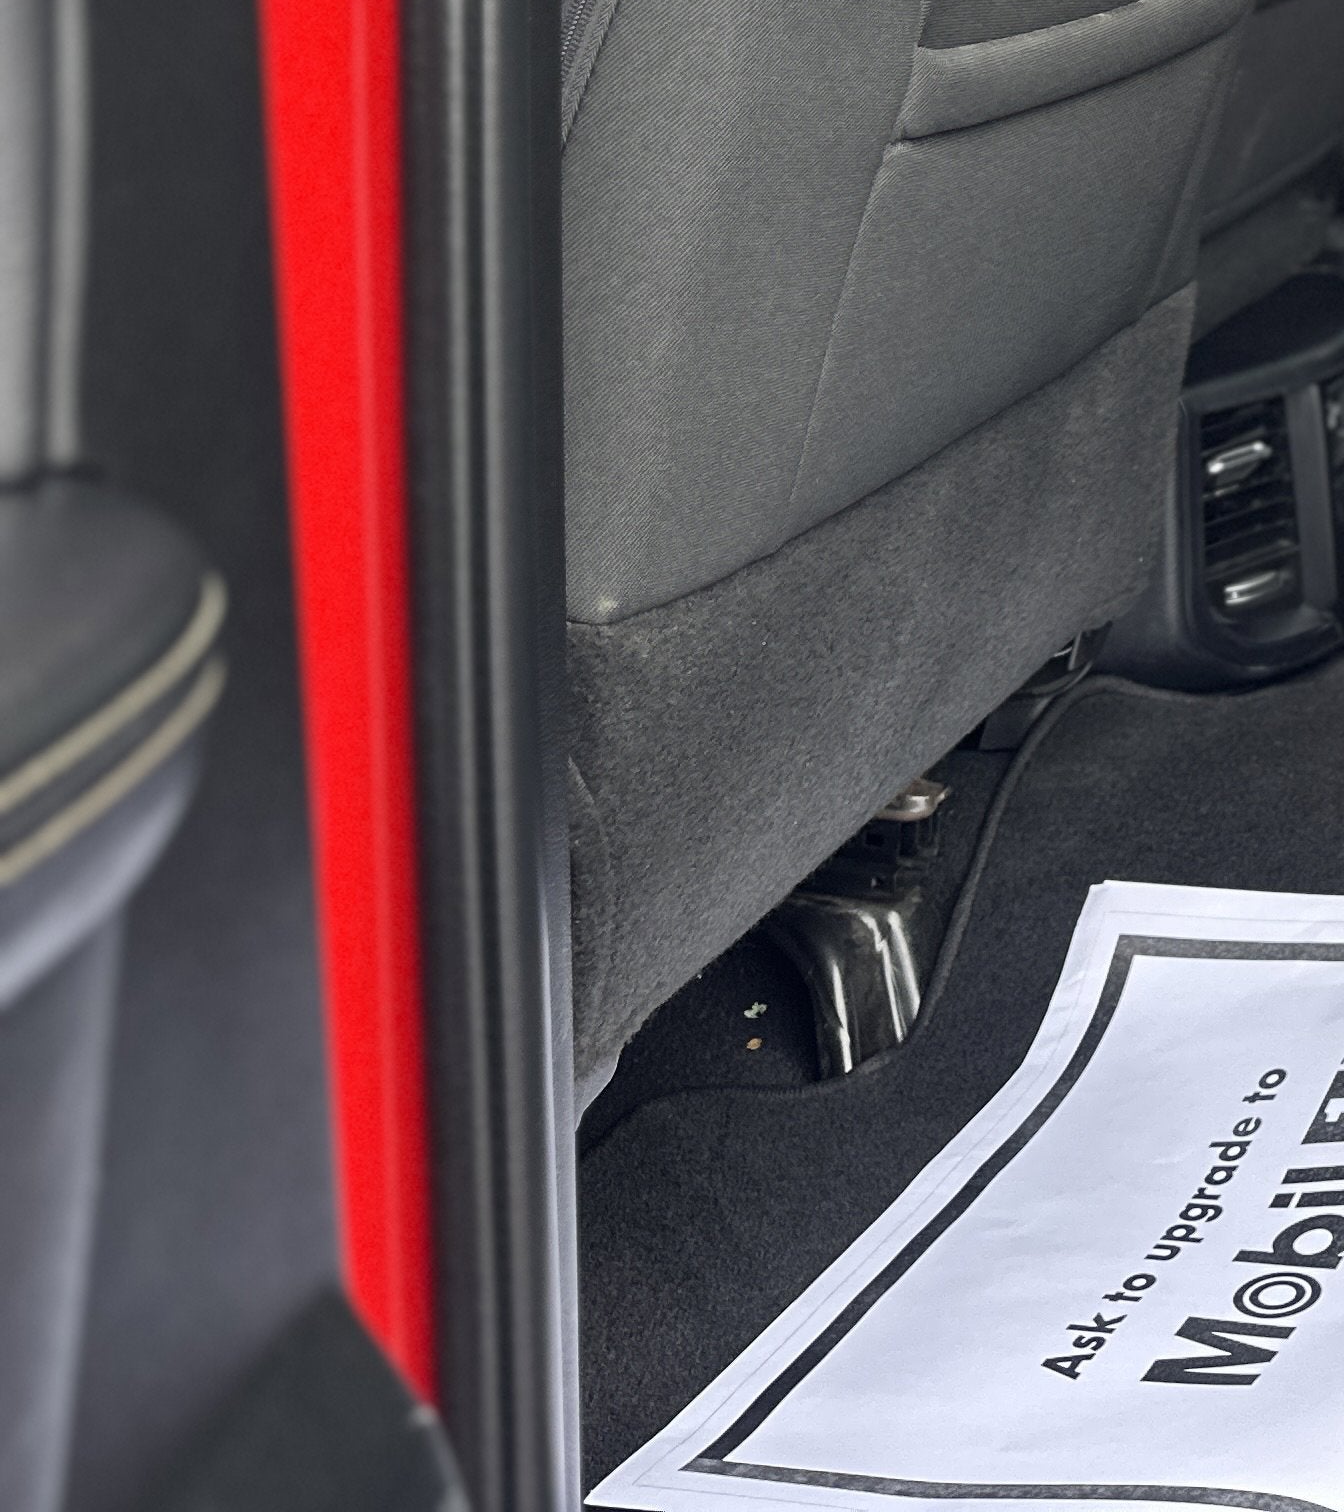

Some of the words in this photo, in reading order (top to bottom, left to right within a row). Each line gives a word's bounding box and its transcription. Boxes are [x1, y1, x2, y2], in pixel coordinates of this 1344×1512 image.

[1040, 1312, 1128, 1380] Ask
[1101, 1273, 1157, 1303] to
[1143, 1117, 1262, 1261] upgrade
[1242, 1068, 1287, 1104] to
